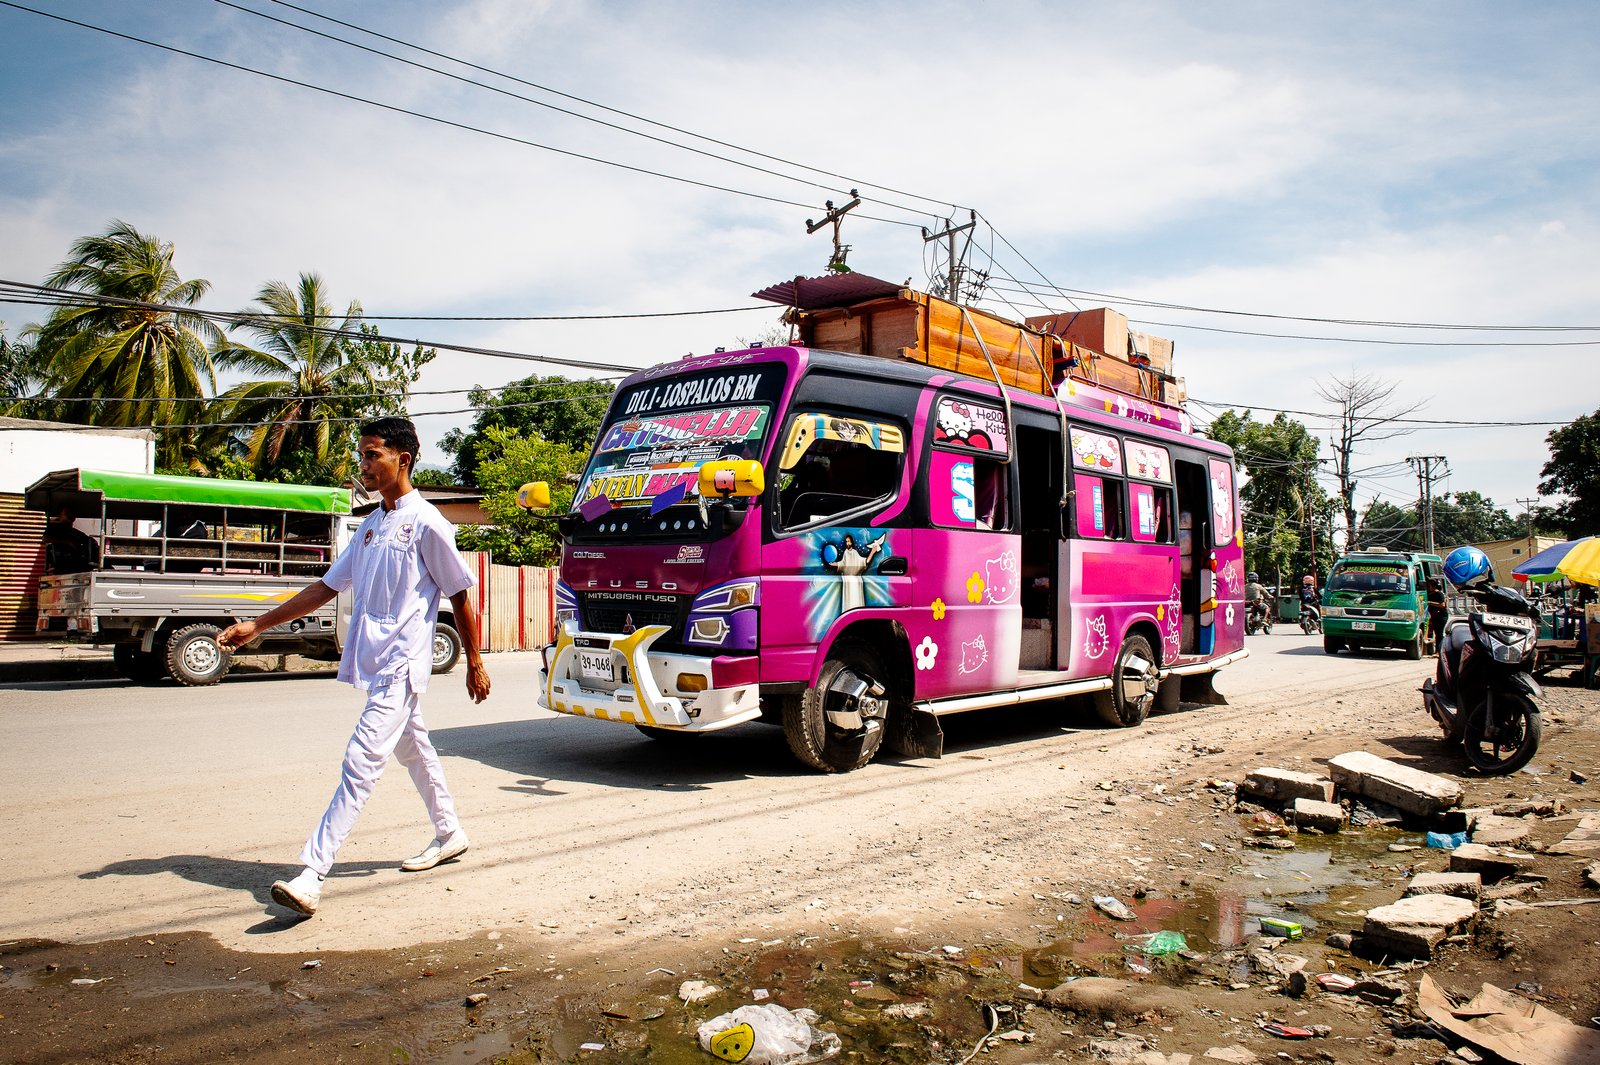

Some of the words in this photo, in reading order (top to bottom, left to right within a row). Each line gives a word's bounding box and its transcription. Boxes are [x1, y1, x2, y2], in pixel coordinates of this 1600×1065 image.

[659, 375, 736, 409] LOSPALOS
[731, 373, 762, 401] BM
[976, 408, 1003, 423] Hell
[985, 421, 1007, 437] Kitt
[587, 579, 677, 590] FUSO
[587, 592, 642, 601] MITSUBISHI
[644, 594, 677, 603] FUSO
[581, 655, 611, 671] 39-068
